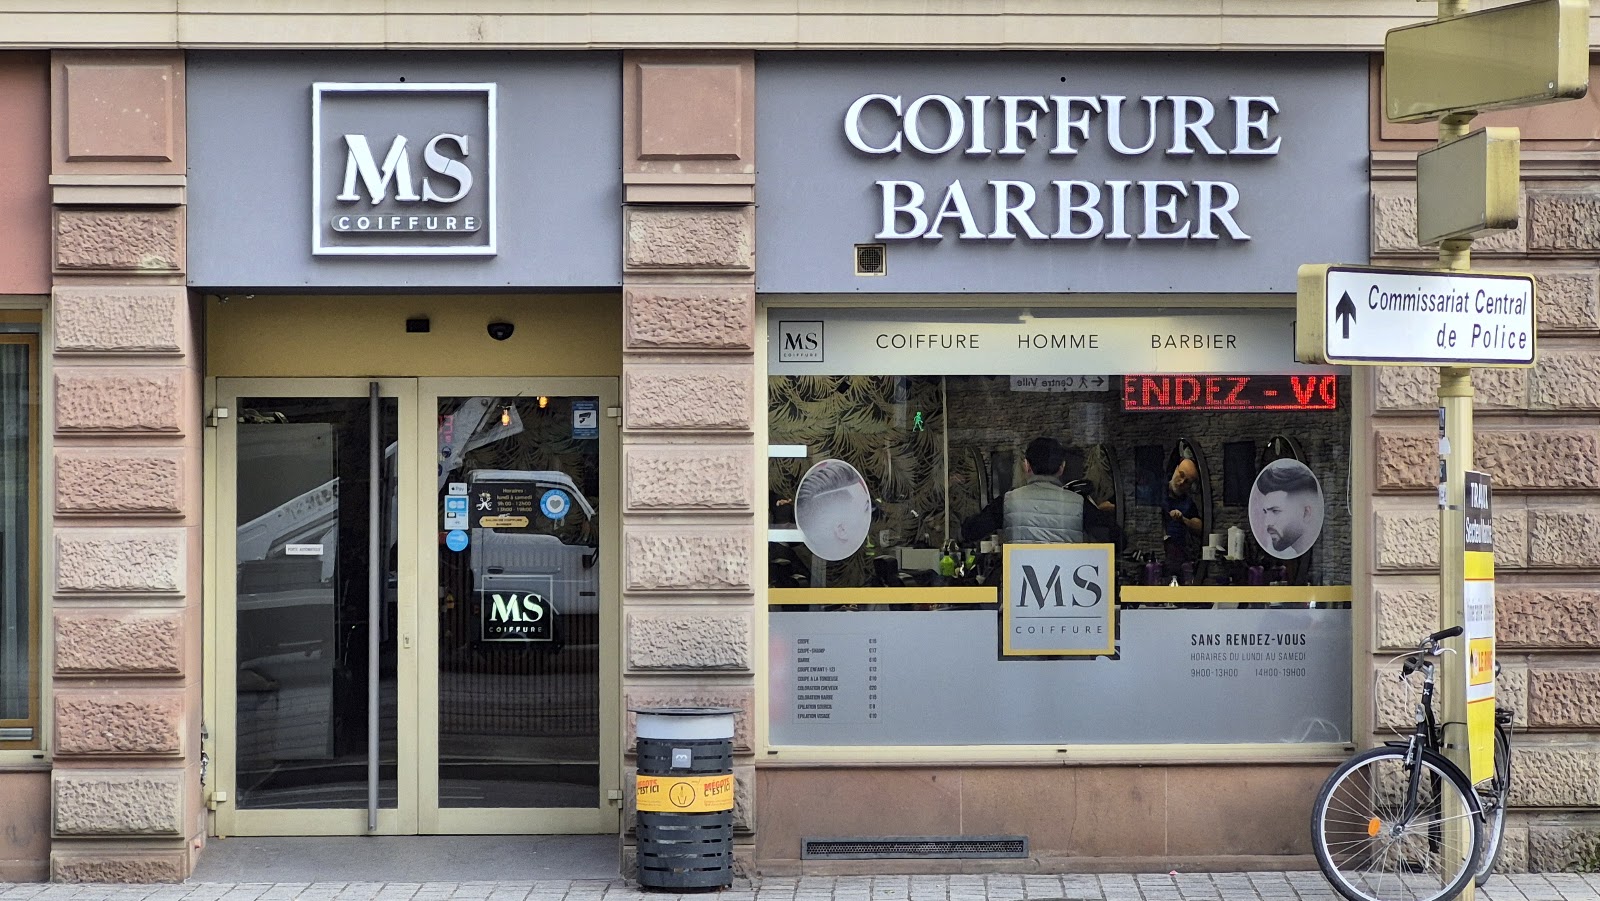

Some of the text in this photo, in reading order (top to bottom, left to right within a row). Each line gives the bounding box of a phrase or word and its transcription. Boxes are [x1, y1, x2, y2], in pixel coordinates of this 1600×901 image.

[844, 93, 1281, 156] COIFFURE
[336, 133, 473, 204] MS
[874, 179, 1251, 240] BARBIER
[338, 216, 475, 230] COIFFURE
[1368, 284, 1527, 315] Commissariat Central
[784, 332, 818, 350] MS
[876, 334, 1237, 349] COIFFURE HOMME BARBIER
[1436, 323, 1527, 349] de Police
[1016, 564, 1102, 610] MS
[489, 593, 543, 623] MS
[1015, 626, 1103, 634] COIFFURE
[1191, 633, 1306, 646] SANS RENDEZ-VOUS
[1190, 652, 1306, 661] HORAIRES DU LUNDI AU SAMEDI
